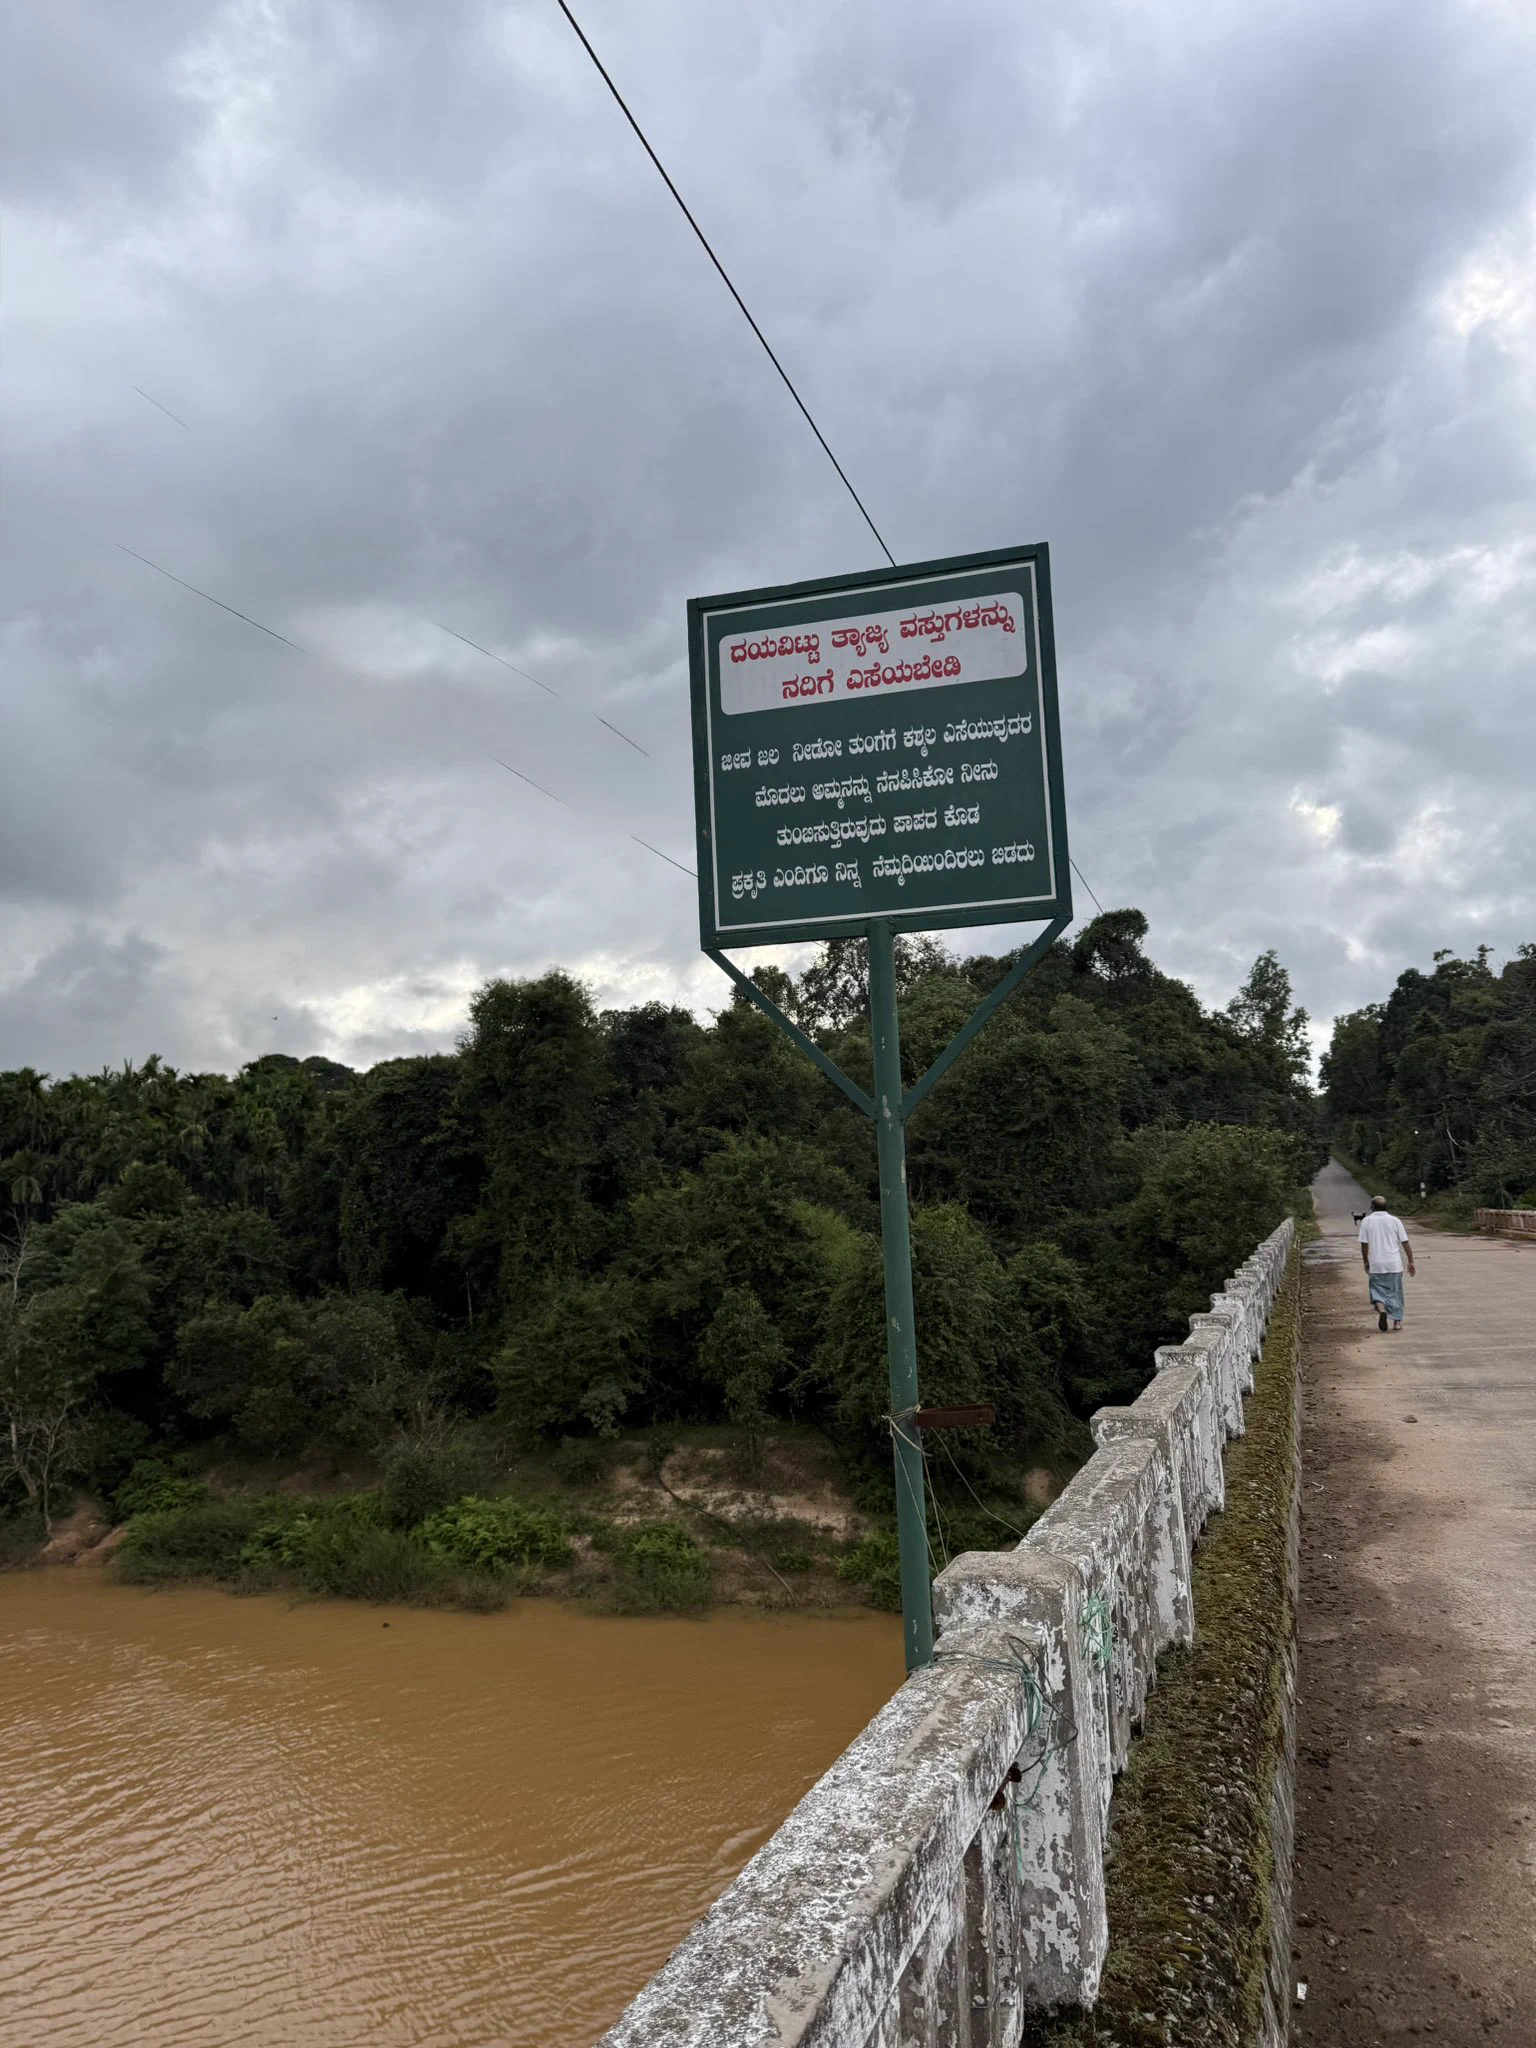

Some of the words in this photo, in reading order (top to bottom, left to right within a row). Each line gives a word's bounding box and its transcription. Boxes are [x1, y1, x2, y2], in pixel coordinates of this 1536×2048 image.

[732, 631, 819, 664] ದಯವಿಟ್ಟು
[832, 626, 887, 656] ತ್ಯಾಜ್ಯ
[901, 600, 1014, 642] ವಸ್ತುಗಳನ್ನು
[784, 669, 834, 699] ನದಿಗೆ
[847, 656, 960, 689] ಎಸೆಯಬೇಡಿ
[722, 748, 751, 771] ಜೀವ
[758, 749, 779, 766] ಜಲ
[793, 738, 842, 762] ನೀಡೋ
[849, 728, 896, 754] ತುಂಗೆಗೆ
[903, 726, 936, 757] ಕಶ್ಮಲ
[943, 712, 1032, 743] ಎಸೆಯುವುದರ
[755, 784, 805, 807] ಮೊದಲು
[812, 775, 872, 809] ಅಮ್ಮನನ್ನು
[876, 765, 954, 793] ನೆನಪಿಸಿಕೋ
[961, 759, 998, 783] ನೀನು
[777, 814, 886, 848] ತುಂಬಿಸುತ್ತಿರುವುದು
[894, 808, 937, 833] ಪಾಪದ
[944, 802, 980, 827] ಕೊಡ
[732, 870, 766, 899] ಪ್ರಕೃತಿ
[773, 863, 828, 887] ಎಂದಿಗೂ
[835, 859, 862, 888] ನಿನ್ನ
[873, 847, 984, 886] ನೆಮ್ಮದಿಯಿಂದಿರಲು
[992, 840, 1034, 864] ಬಿಡದು
